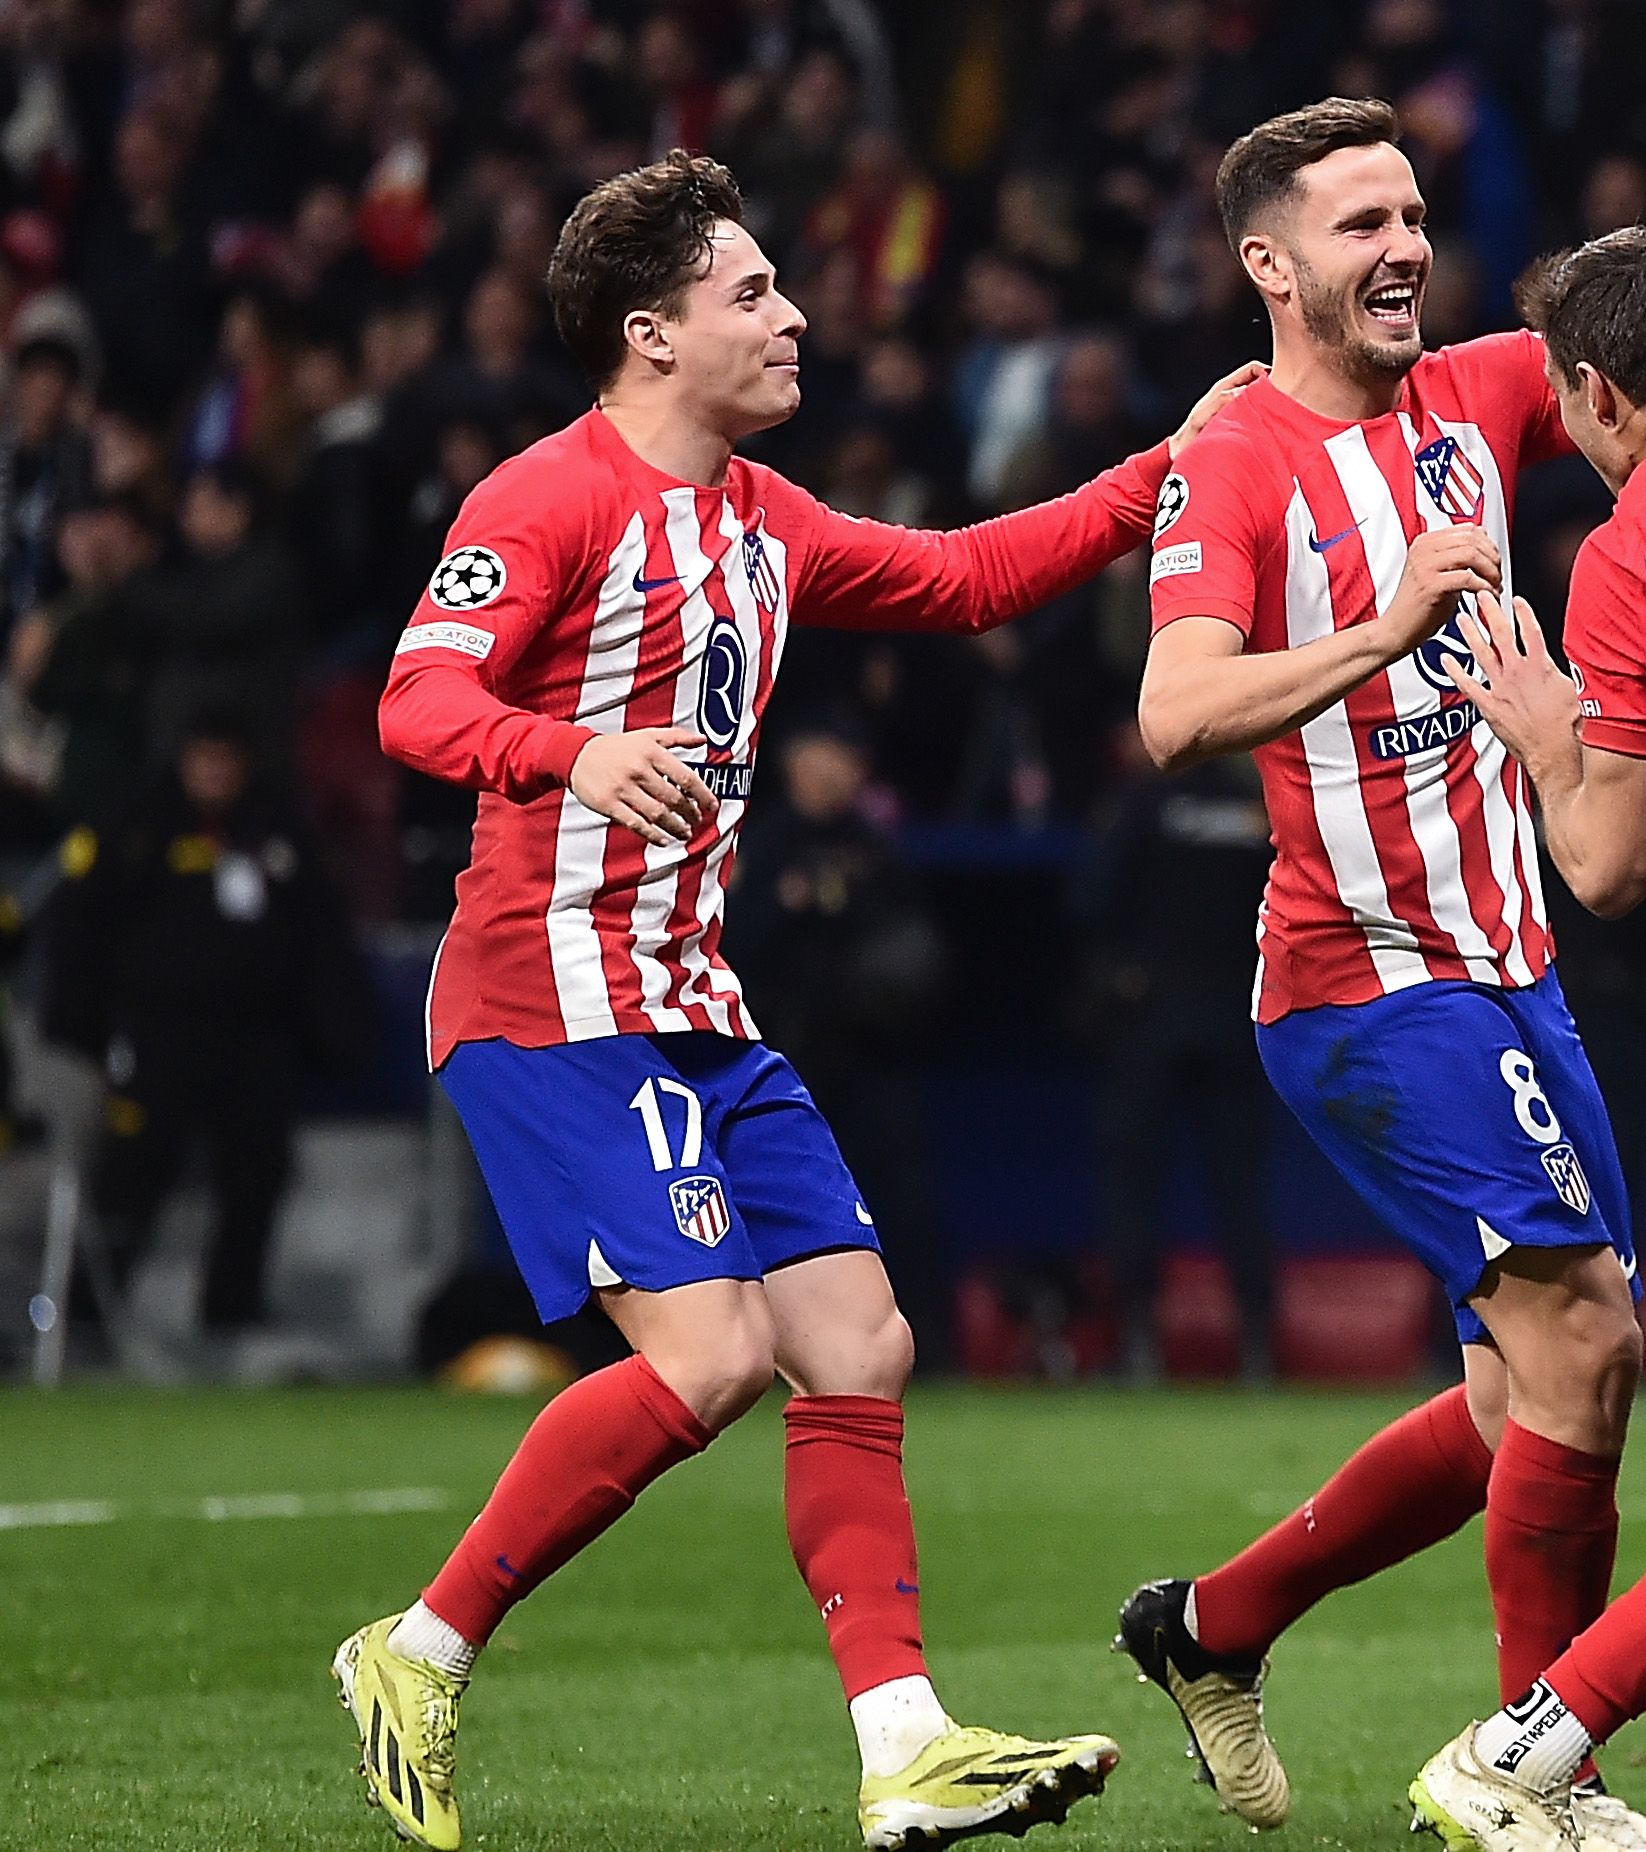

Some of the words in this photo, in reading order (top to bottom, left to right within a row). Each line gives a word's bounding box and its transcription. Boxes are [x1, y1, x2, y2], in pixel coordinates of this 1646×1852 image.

[1378, 703, 1476, 757] RIYADH
[629, 1077, 702, 1172] 17
[1500, 1049, 1561, 1144] 8
